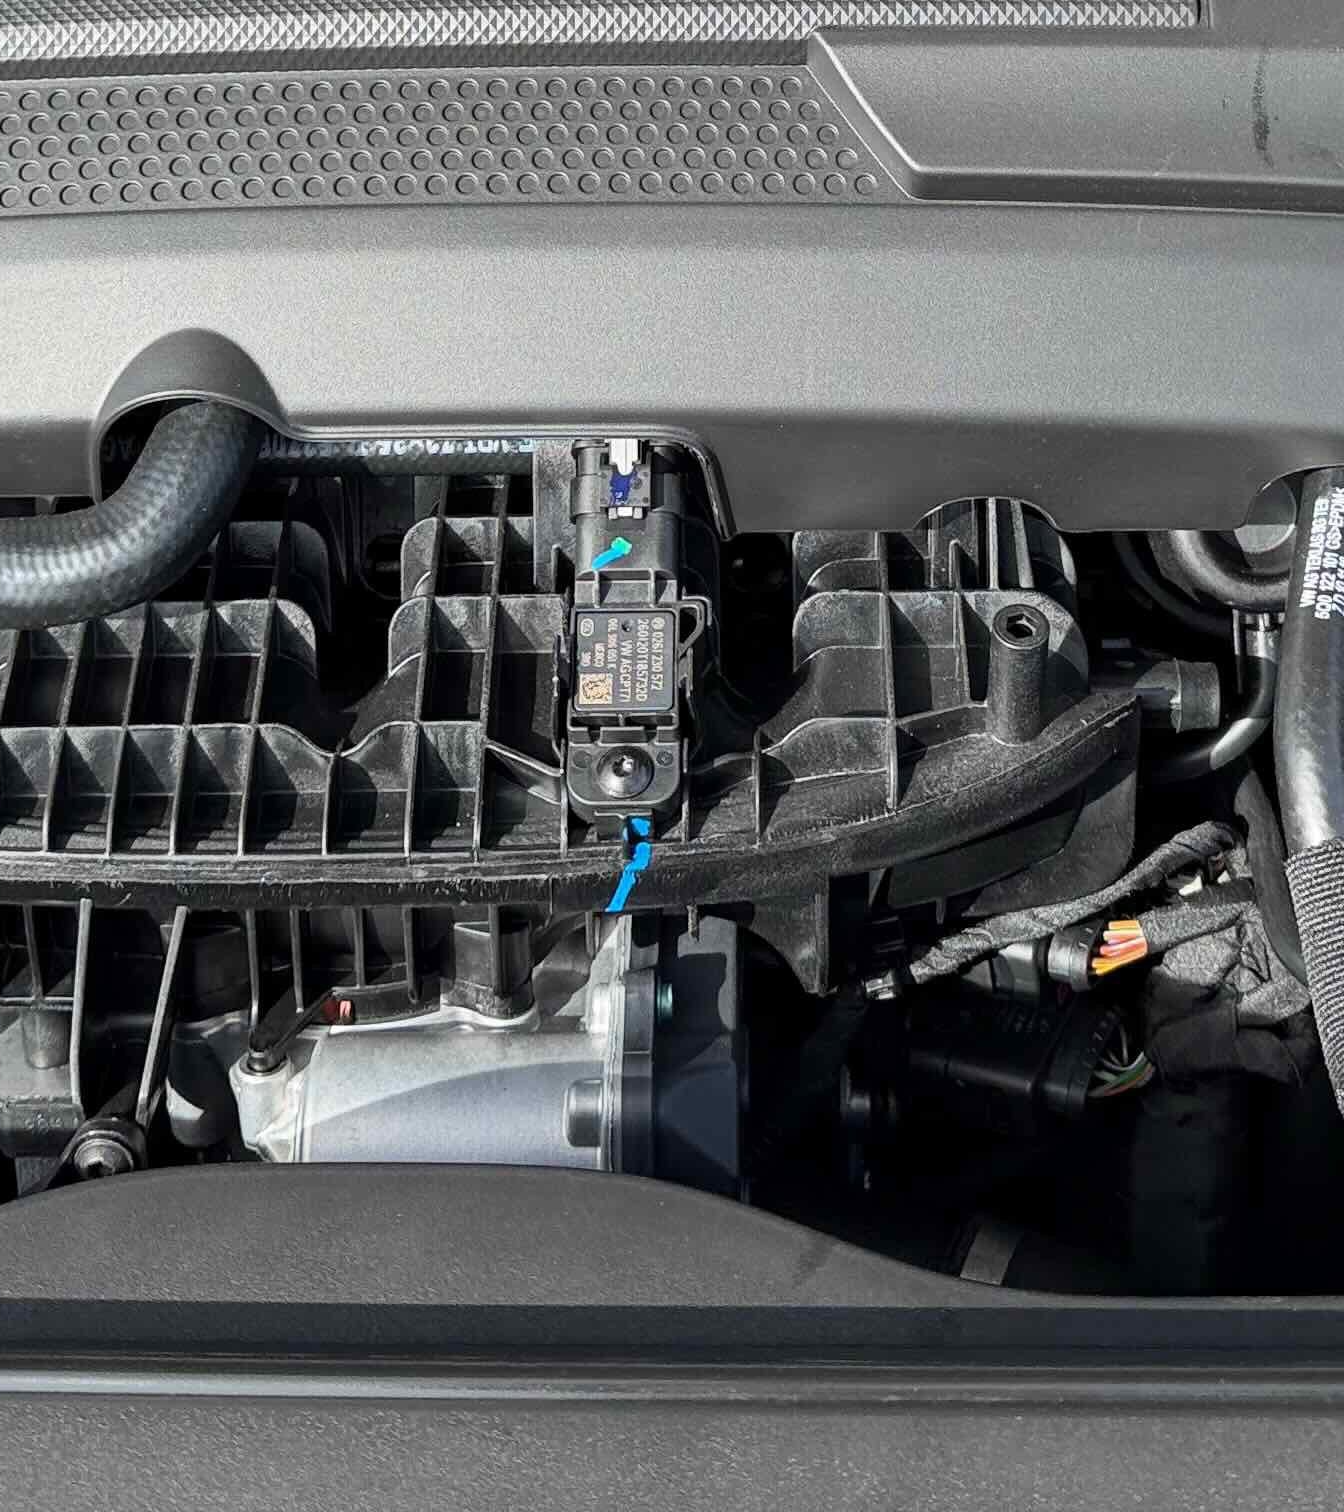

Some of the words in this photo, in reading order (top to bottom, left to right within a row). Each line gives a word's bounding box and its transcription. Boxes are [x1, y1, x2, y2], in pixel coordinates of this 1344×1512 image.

[1322, 552, 1339, 569] 101
[1319, 572, 1336, 591] 122
[1299, 590, 1317, 608] VW
[620, 640, 633, 657] VW
[620, 657, 633, 673] AG
